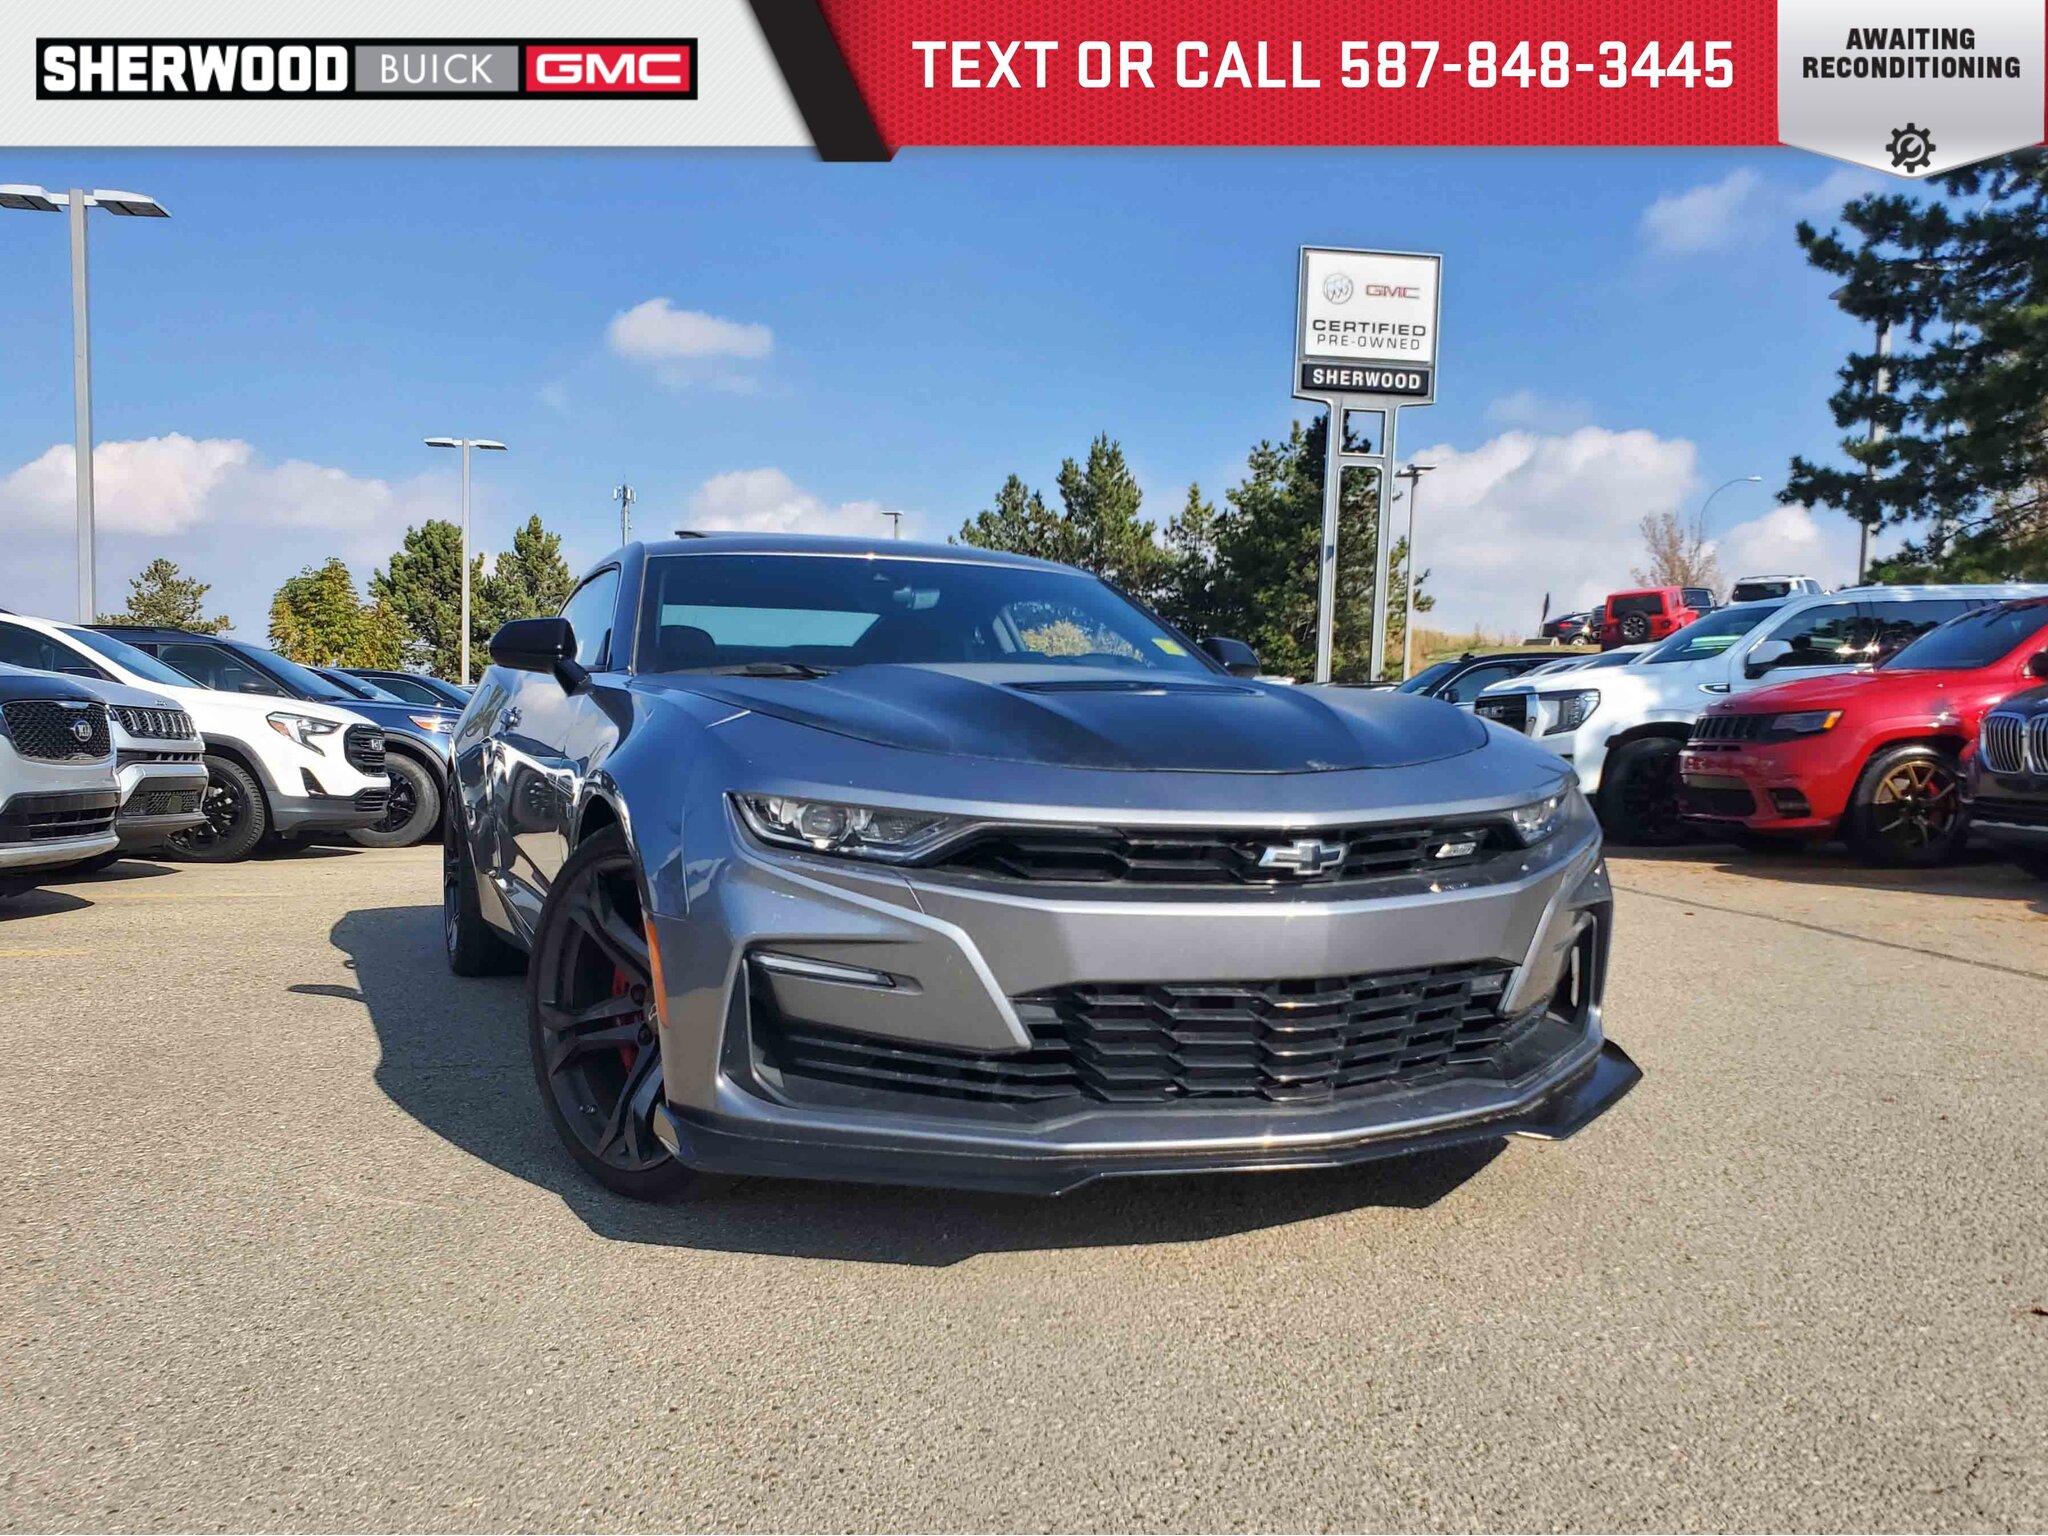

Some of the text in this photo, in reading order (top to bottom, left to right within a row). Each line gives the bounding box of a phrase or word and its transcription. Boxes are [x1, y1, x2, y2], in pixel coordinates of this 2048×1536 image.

[1366, 284, 1420, 299] GMC
[1312, 319, 1426, 336] CERTIFIED
[1317, 333, 1420, 350] PRE-OWNED
[1312, 368, 1421, 389] SHERWOOD
